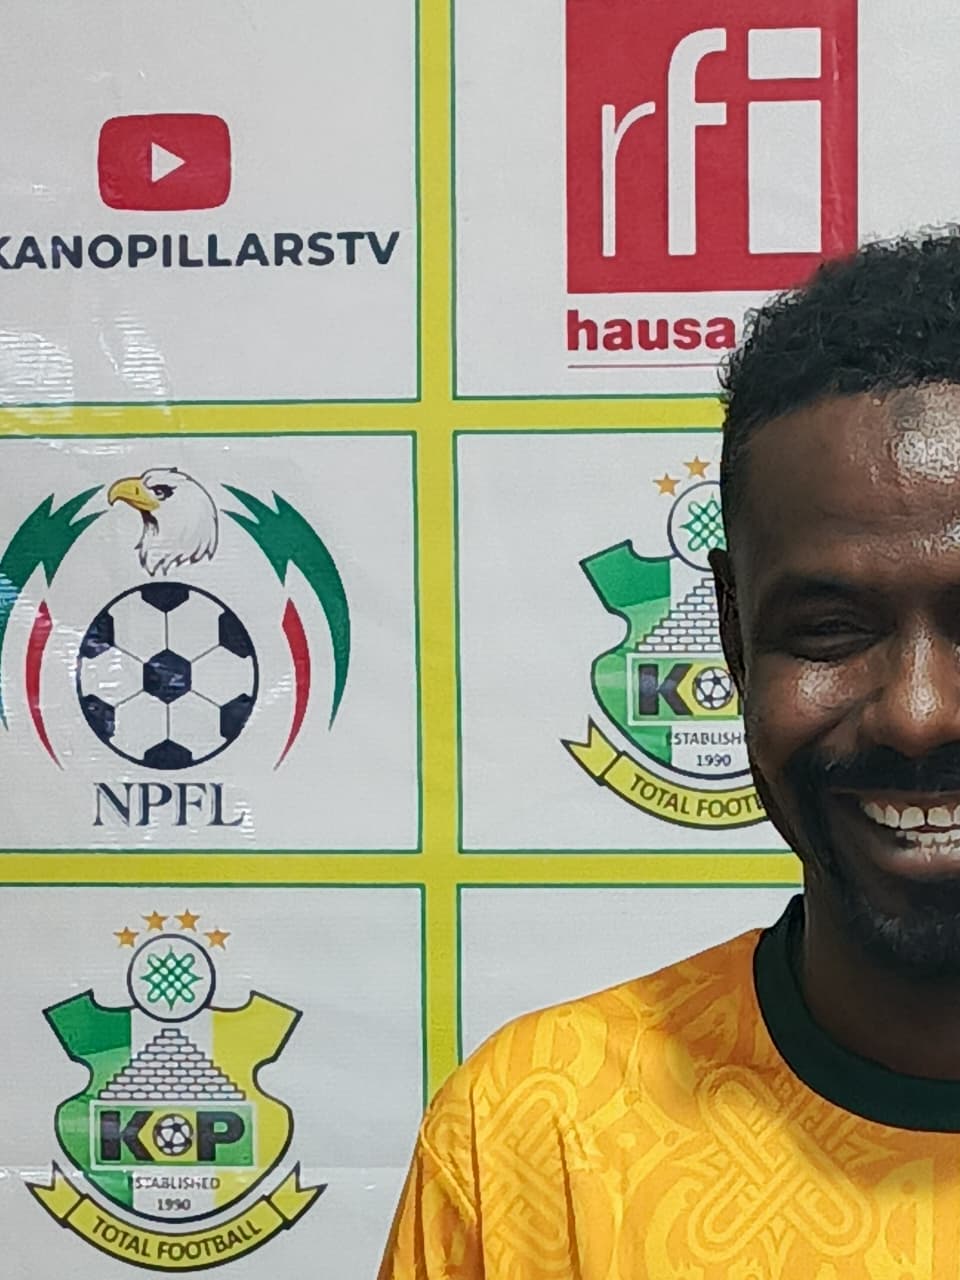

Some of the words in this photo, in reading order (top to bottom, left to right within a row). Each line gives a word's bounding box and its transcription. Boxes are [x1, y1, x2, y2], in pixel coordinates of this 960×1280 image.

[602, 27, 822, 257] rfi
[567, 309, 736, 351] hausa
[666, 732, 745, 746] ESTABLISH
[696, 753, 732, 767] 1990
[93, 782, 246, 827] NPFL
[629, 772, 690, 815] TOTAL
[697, 792, 763, 818] FOOT
[157, 1198, 192, 1211] 1990
[92, 1215, 151, 1258] TOTAL
[157, 1220, 263, 1262] FOOTBALL
